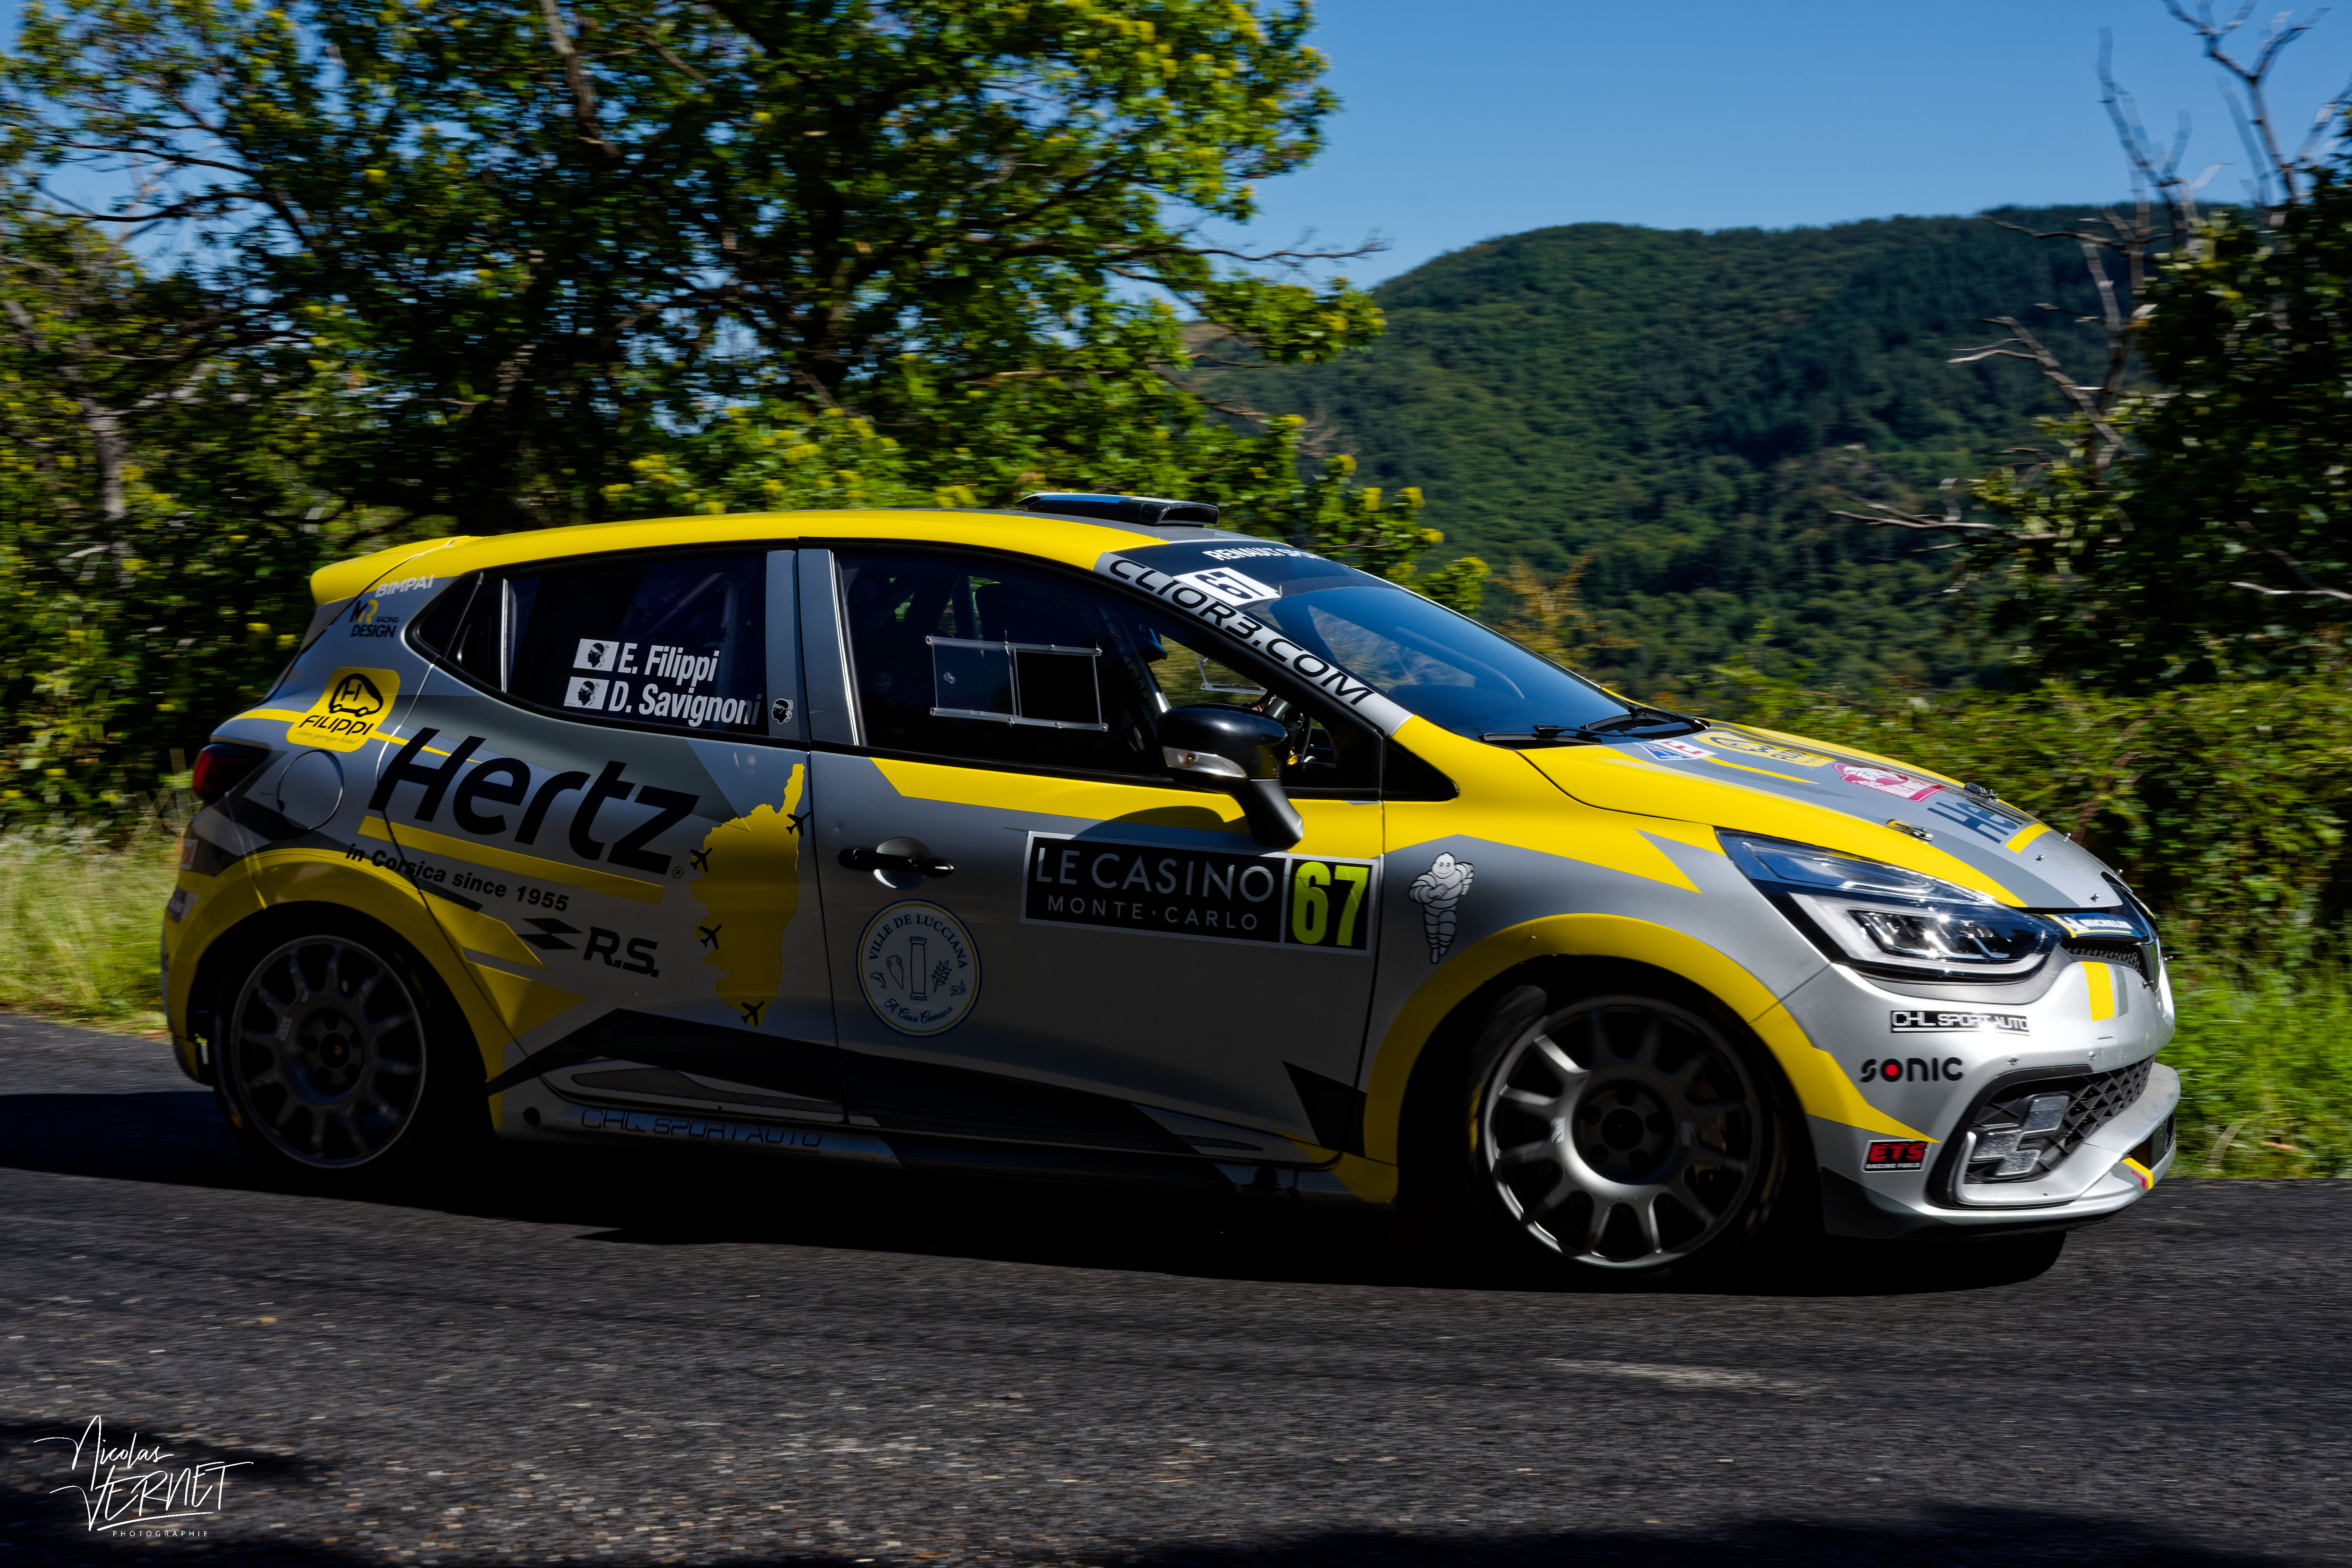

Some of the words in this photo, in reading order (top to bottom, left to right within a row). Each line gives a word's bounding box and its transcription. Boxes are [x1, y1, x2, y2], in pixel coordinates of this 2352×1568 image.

[1202, 547, 1285, 561] RENAULT
[375, 574, 434, 598] BIMPAI
[1195, 571, 1265, 600] 67
[350, 624, 397, 638] DESIGN
[1109, 559, 1375, 706] CLIOR3.COM
[617, 642, 638, 674] E.
[644, 645, 720, 687] Filippi
[608, 681, 632, 713] D.
[638, 683, 762, 727] Savignoni
[298, 715, 375, 735] FILIPPI
[309, 734, 339, 743] garage
[367, 727, 701, 875] Hertz
[345, 843, 365, 862] in
[371, 848, 446, 883] Corsica
[452, 871, 507, 898] since
[516, 885, 570, 912] 1955
[1036, 848, 1081, 885] LE
[1092, 853, 1274, 902] CASINO
[1292, 861, 1369, 946] 67
[2078, 919, 2135, 930] MICHELIN
[583, 926, 660, 978] R.S.
[869, 924, 893, 960] VILLE
[893, 914, 912, 929] DE
[916, 914, 968, 969] LUCCIANA
[898, 1007, 918, 1022] Casa
[1892, 1011, 1936, 1026] CHL
[581, 1108, 646, 1133] CHL
[1868, 1143, 1927, 1161] ETS
